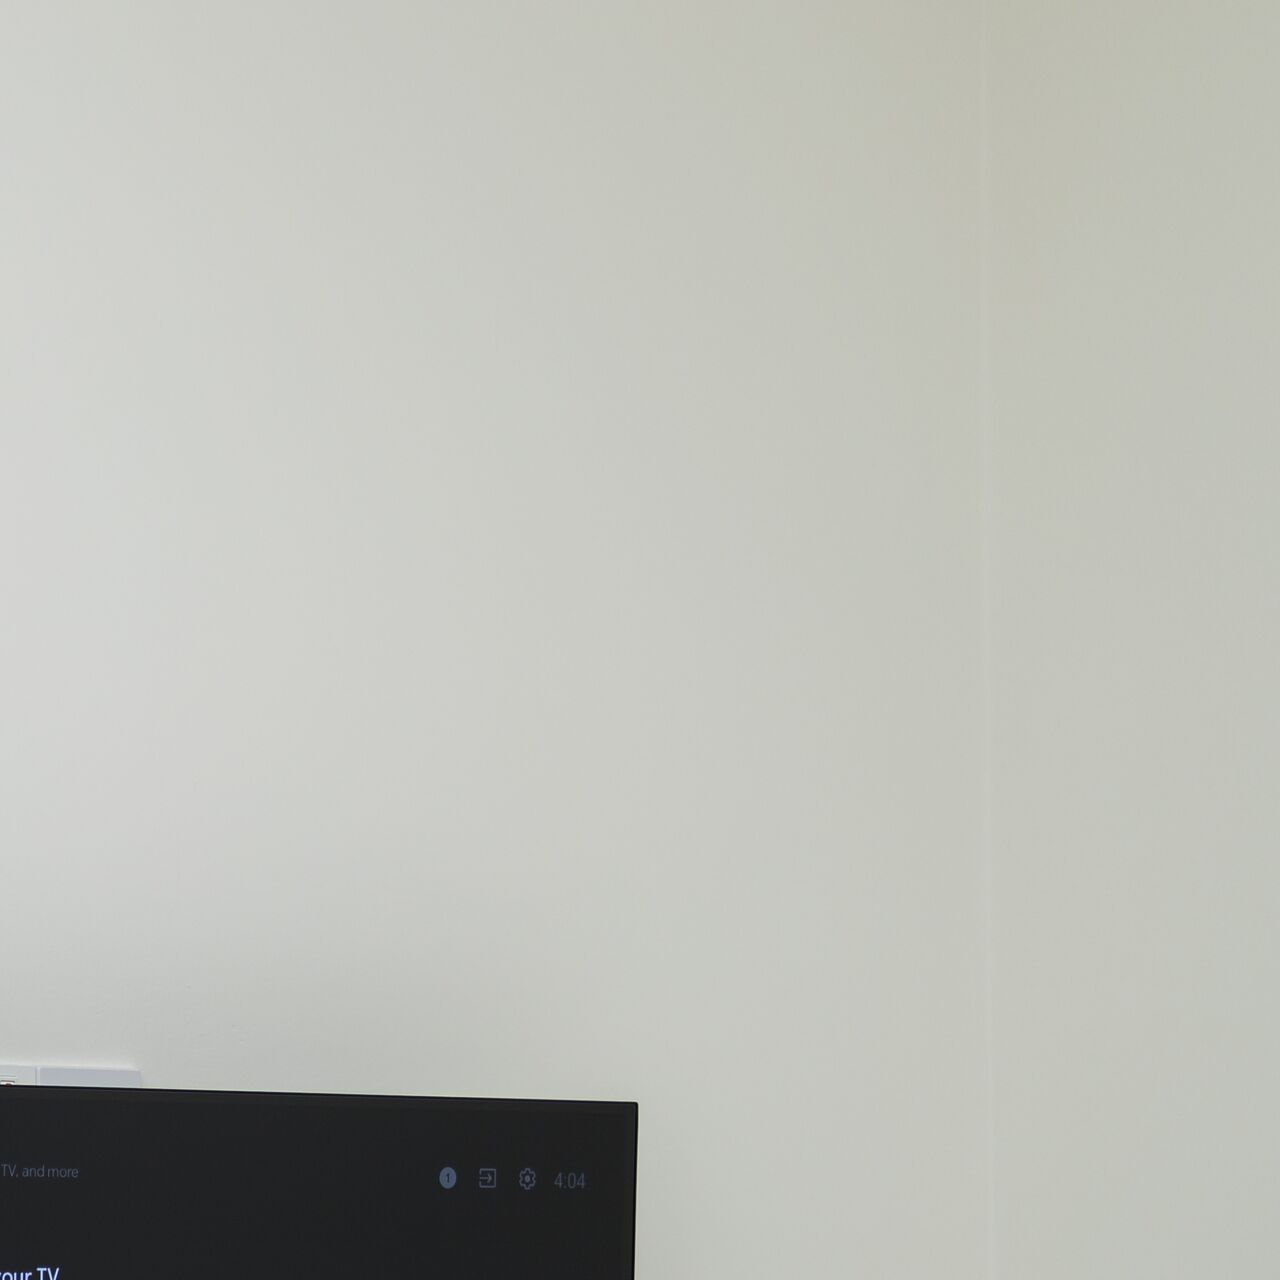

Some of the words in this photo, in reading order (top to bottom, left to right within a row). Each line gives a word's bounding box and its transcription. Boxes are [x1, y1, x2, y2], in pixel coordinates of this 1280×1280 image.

[22, 1164, 45, 1178] and
[47, 1167, 80, 1178] more
[553, 1172, 586, 1189] 4:04
